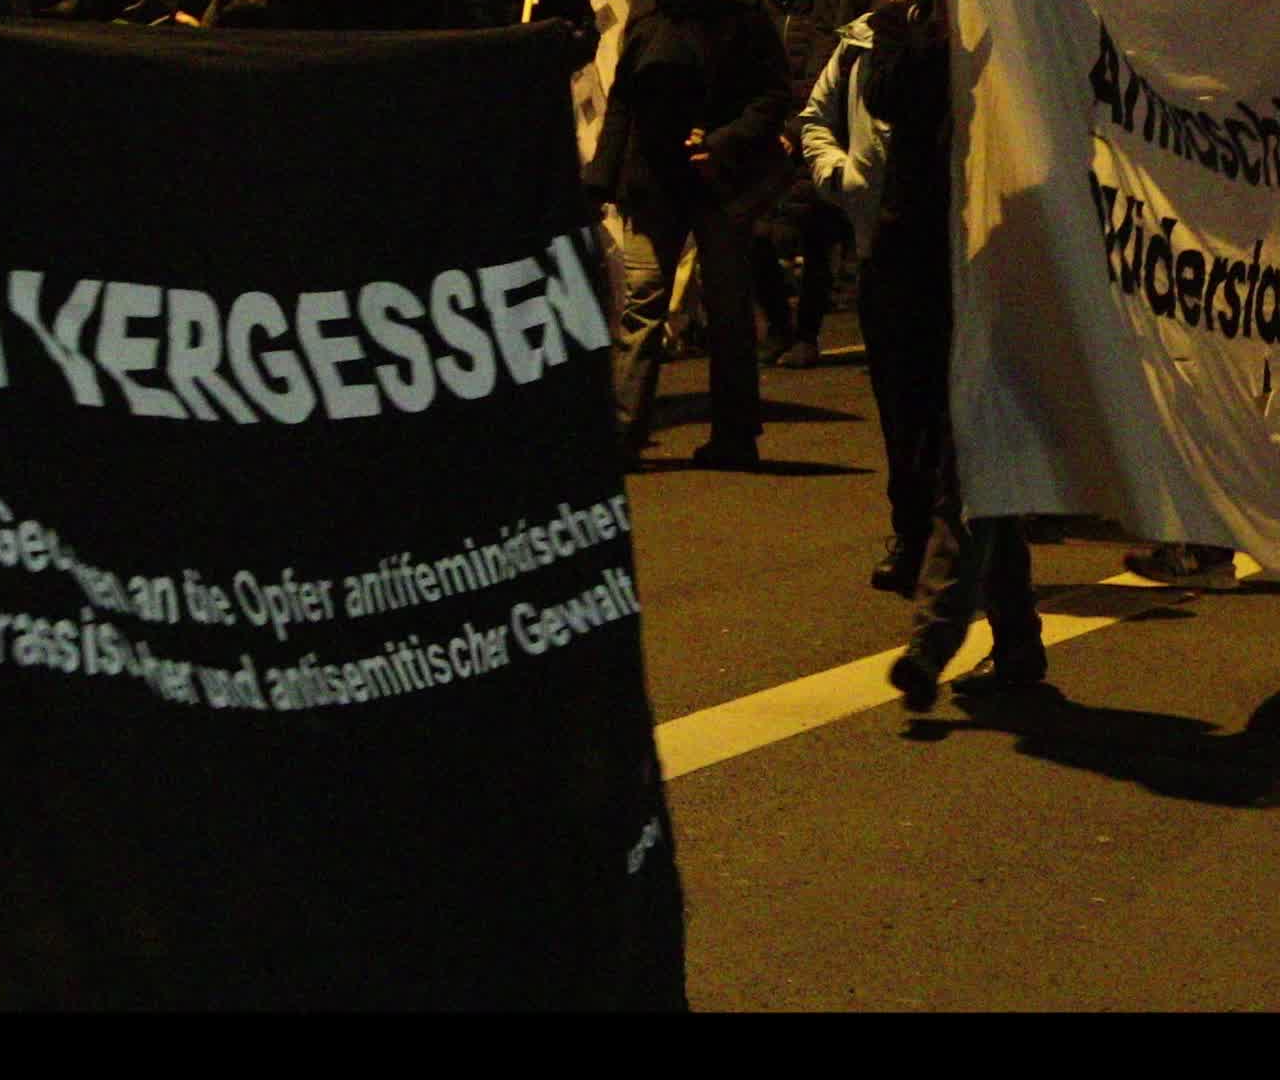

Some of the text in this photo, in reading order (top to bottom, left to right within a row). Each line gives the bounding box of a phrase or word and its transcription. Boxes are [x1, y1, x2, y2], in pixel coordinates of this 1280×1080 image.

[6, 225, 614, 425] VERGESSEN
[126, 575, 181, 624] an
[232, 569, 336, 642] Opfer
[265, 621, 514, 711] antisemitischer
[509, 565, 642, 655] Gewalt
